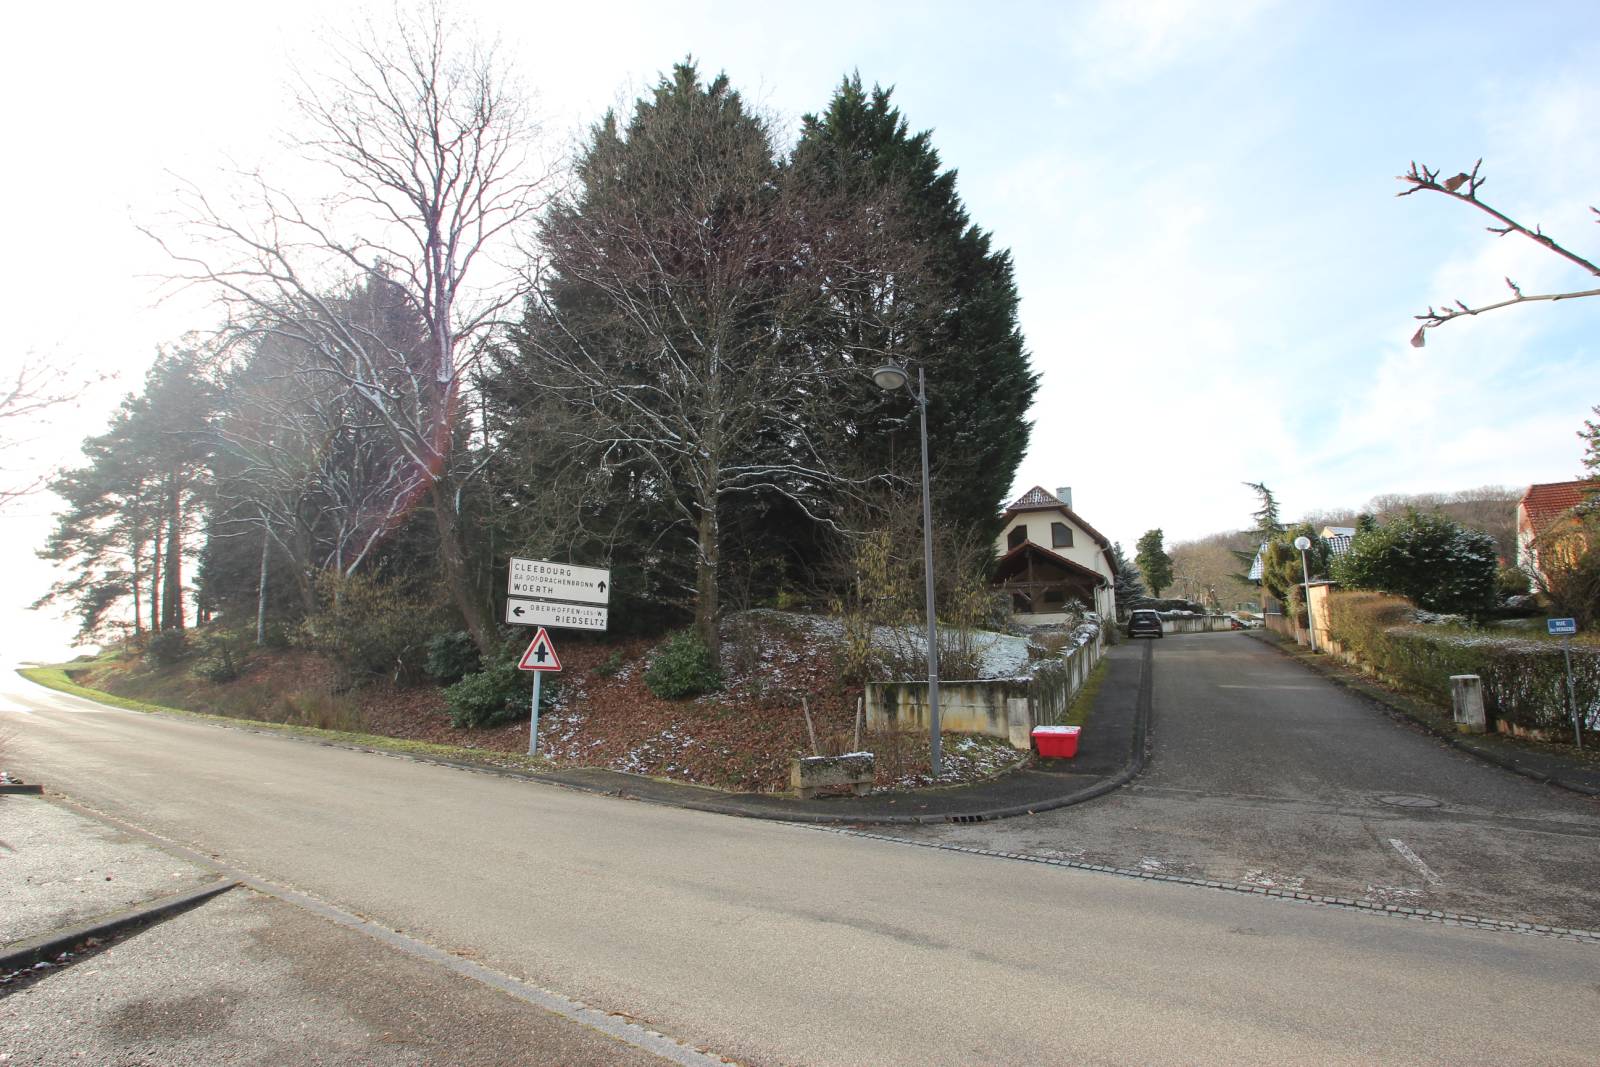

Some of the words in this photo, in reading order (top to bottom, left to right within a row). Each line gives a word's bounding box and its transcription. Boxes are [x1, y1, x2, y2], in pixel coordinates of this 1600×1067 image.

[515, 563, 572, 577] CLEEBOURG
[513, 583, 553, 594] WOERTH
[555, 615, 605, 627] RIEDSELTZ
